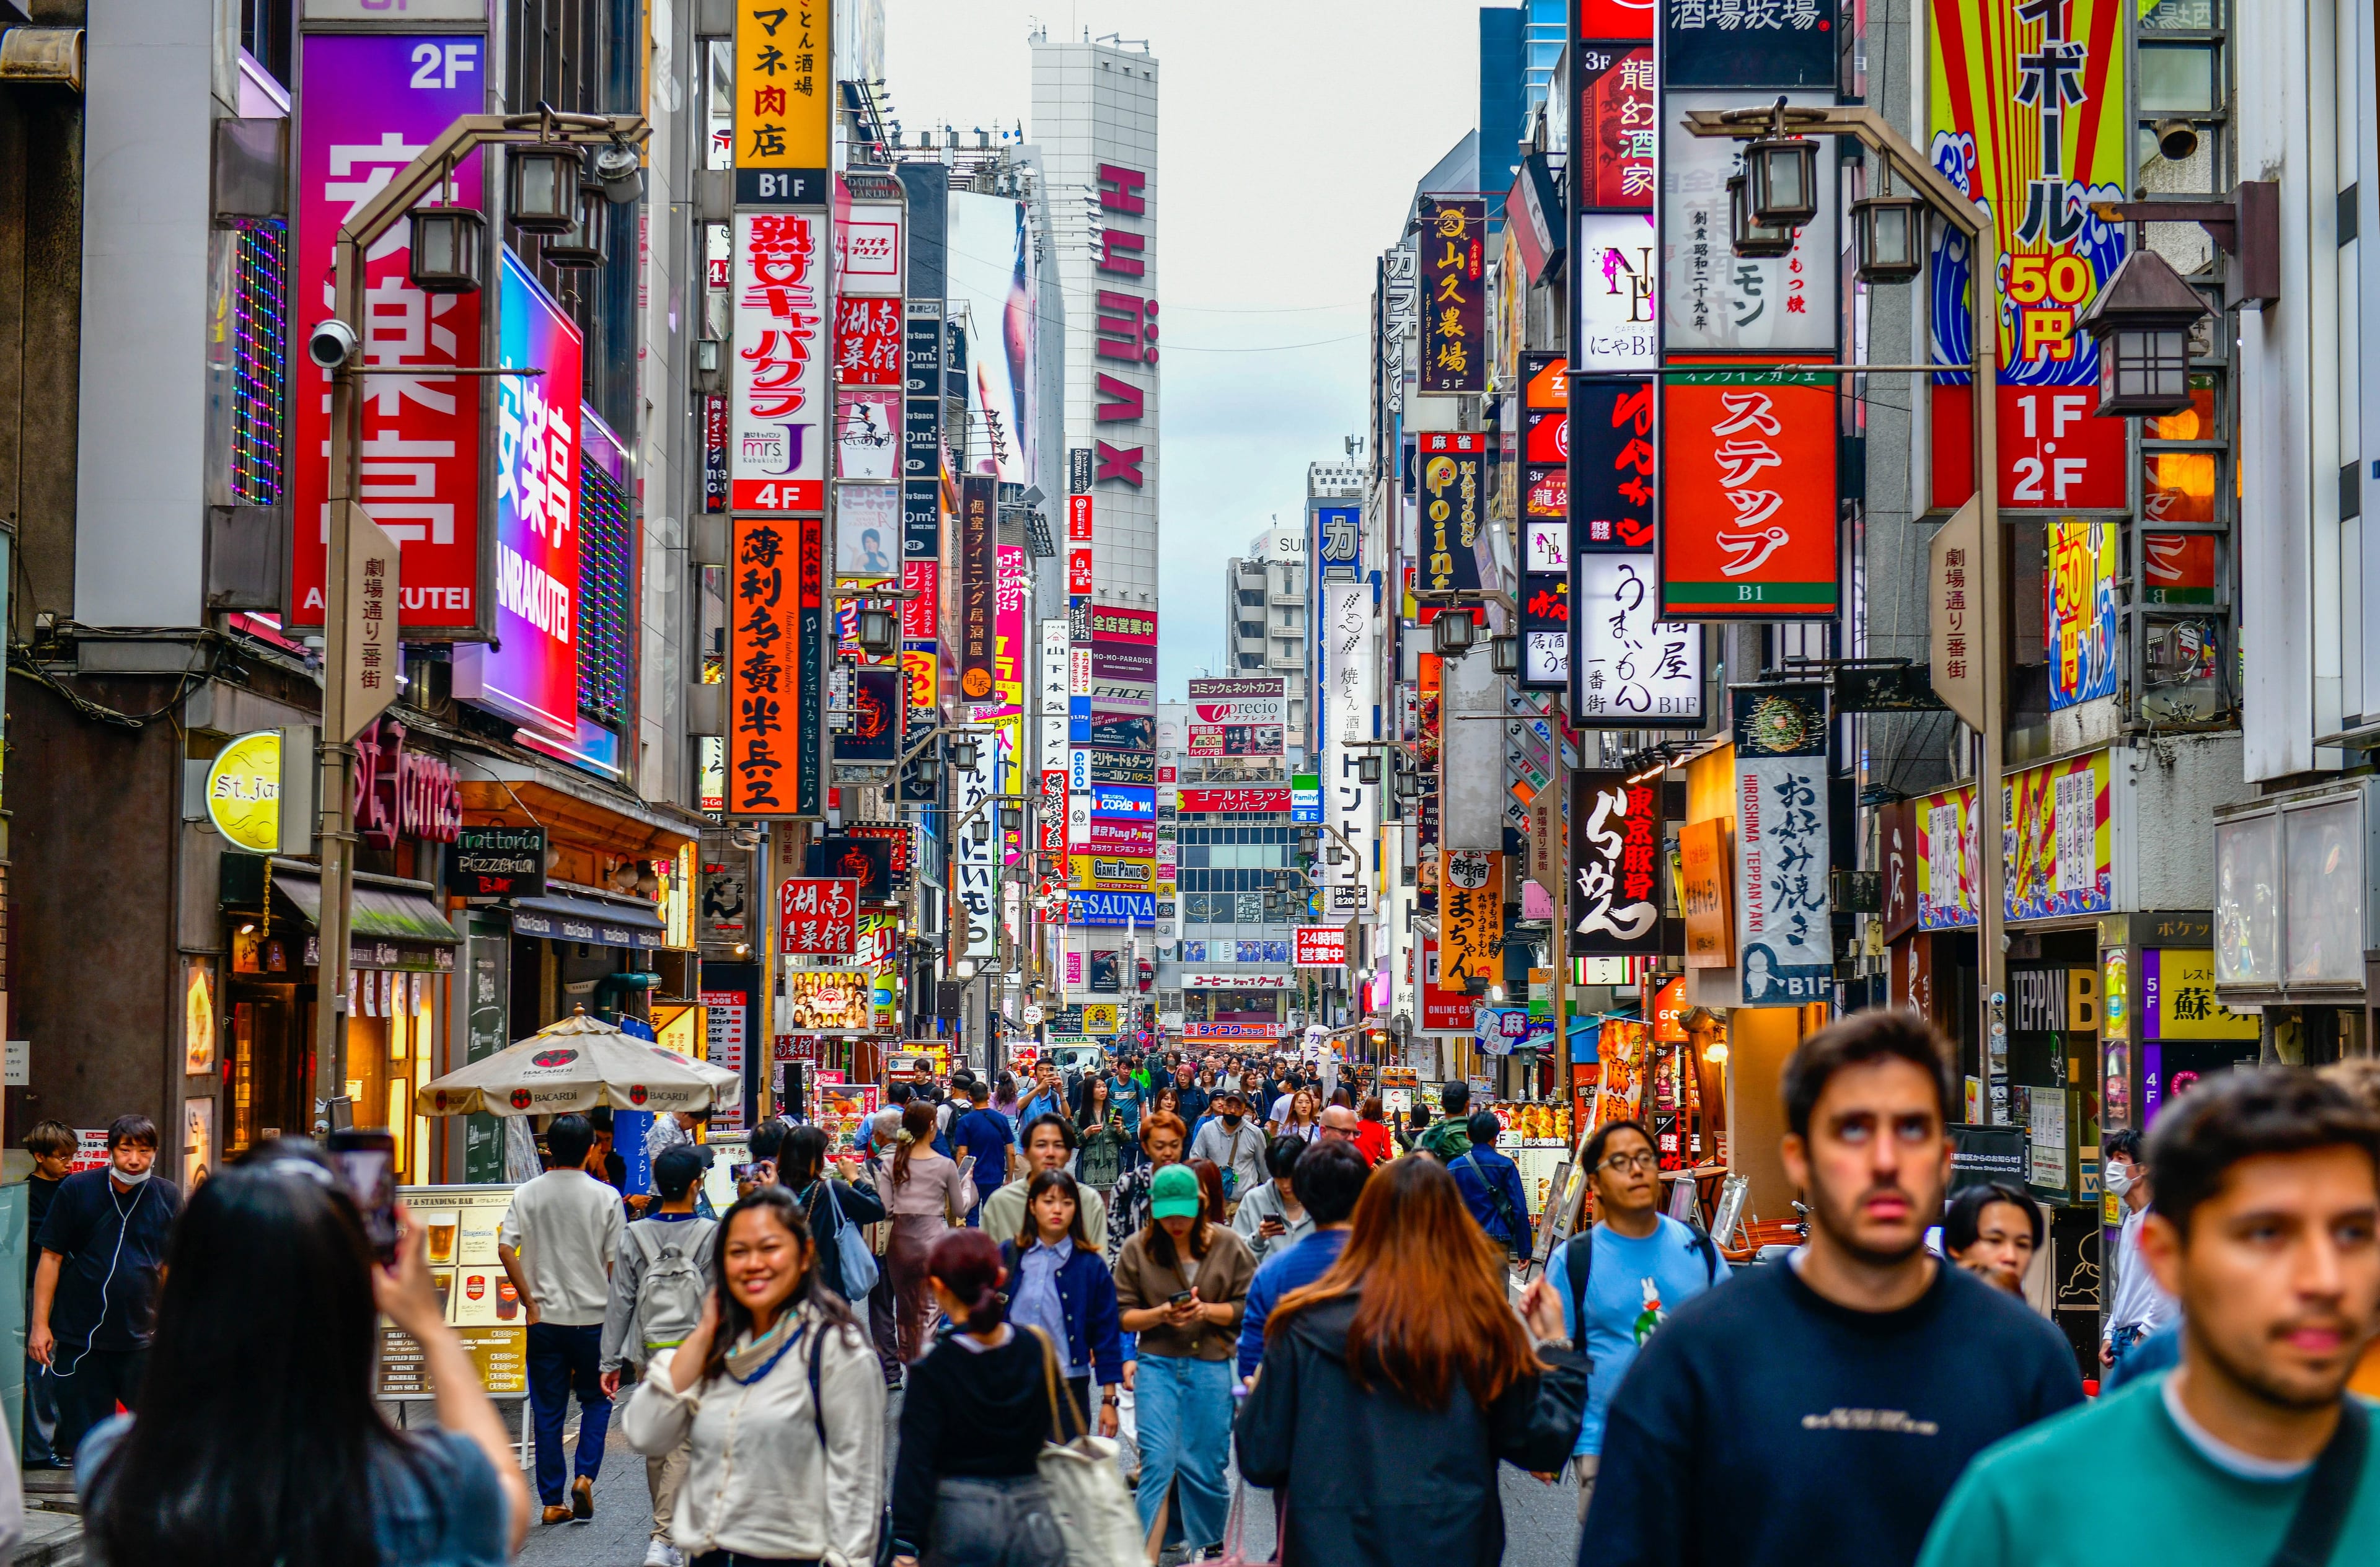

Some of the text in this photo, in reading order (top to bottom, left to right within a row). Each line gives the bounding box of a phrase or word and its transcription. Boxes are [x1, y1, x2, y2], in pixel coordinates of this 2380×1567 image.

[1671, 0, 1820, 30] 酒場牧場
[410, 43, 477, 89] 2F
[1585, 50, 1611, 71] 3F
[1619, 58, 1654, 196] 龍幻酒家
[2013, 0, 2089, 247] イボール
[759, 173, 804, 197] B1F
[851, 247, 891, 255] ラウンジ
[856, 237, 888, 245] カブキ
[1693, 211, 1709, 331] 創業昭和二十九年
[907, 305, 939, 314] 桑原ビル
[1435, 242, 1468, 372] 山久農場
[840, 301, 899, 336] 湖南
[859, 372, 880, 383] 4F
[1530, 362, 1544, 371] 5F
[1441, 379, 1465, 389] 5F
[1529, 415, 1541, 425] 4F
[1432, 435, 1473, 450] 麻雀
[1529, 470, 1544, 481] 3F
[1711, 391, 1789, 577] ステップ
[755, 483, 800, 508] 4F
[1460, 461, 1476, 548] MAHJONG
[802, 527, 819, 598] 炭火串焼
[1075, 558, 1091, 586] 白木屋
[969, 499, 985, 656] 個室ダイニング居酒屋
[304, 587, 470, 610] AUTEI
[496, 542, 569, 644] ANRAKUTEI
[905, 563, 919, 636] リフッシュ
[924, 563, 932, 633] レンタルルーム ホステル
[1738, 585, 1763, 600] B1
[361, 558, 385, 689] 劇場通り一番街
[786, 610, 794, 639] Hakuri
[1945, 547, 1967, 680] 劇場通り一番街
[1093, 614, 1154, 636] 全店営業中
[1608, 564, 1651, 713] うまいもん
[1093, 653, 1153, 664] MO-MO-PARADISE
[966, 672, 990, 693] 旬香
[1082, 658, 1090, 687] カラオケ
[1093, 686, 1154, 700] FACE
[1191, 682, 1282, 694] コミック&ネットカフェ
[1586, 658, 1607, 714] 一番街
[1046, 647, 1065, 765] 山下本気うどん
[1212, 698, 1278, 721] aprecio
[1341, 667, 1360, 741] 焼とん酒場
[1510, 697, 1522, 708] 4
[1659, 697, 1696, 714] B1F
[1191, 726, 1223, 735] 新宿最大
[1510, 724, 1522, 735] 3
[1091, 752, 1155, 769] ビリヤード&ダーツ
[1190, 748, 1223, 756] ハイジアB1
[1509, 751, 1522, 763] 2
[1074, 752, 1085, 788] GiGO
[1109, 770, 1154, 782] ゴルフ バグース
[213, 775, 280, 802] St.Ja
[1218, 802, 1269, 811] ハンバーグ
[1297, 811, 1307, 820] 酒
[1508, 804, 1525, 821] B1
[1743, 774, 1760, 843] HIROSHIMA
[457, 830, 542, 851] Trattoria
[1092, 825, 1153, 842] 東京 Ping Pong
[1536, 806, 1548, 871] 劇場通り一番街
[1623, 785, 1655, 900] 東京豚骨
[1094, 859, 1141, 877] GAME PANIC
[1450, 858, 1487, 879] 新宿
[1767, 772, 1826, 946] お好み焼き
[1463, 877, 1476, 888] の
[785, 880, 852, 919] 湖南
[1089, 894, 1155, 916] SAUNA
[1488, 892, 1498, 930] 博多もつ鍋
[783, 921, 797, 950] 4F
[1448, 891, 1476, 980] まっちゃん
[1478, 893, 1487, 958] 九州のうまかもん
[1300, 932, 1344, 946] 24時間
[1300, 947, 1344, 961] 営業中
[1787, 977, 1831, 995] B1F
[2146, 977, 2158, 1009] 5F
[1429, 1006, 1456, 1014] ONLINE
[2012, 968, 2065, 1032] TEPPAN
[1184, 1024, 1196, 1035] 薬
[1449, 1017, 1458, 1025] B1
[1528, 1016, 1553, 1024] フリー
[1656, 1048, 1667, 1056] 3F
[819, 1074, 837, 1082] Pink
[2146, 1072, 2157, 1104] 4F
[534, 1090, 578, 1102] BACARDÍ
[649, 1091, 689, 1101] BACARDÍ
[638, 1116, 647, 1187] とうがらし
[420, 1198, 457, 1206] STANDING
